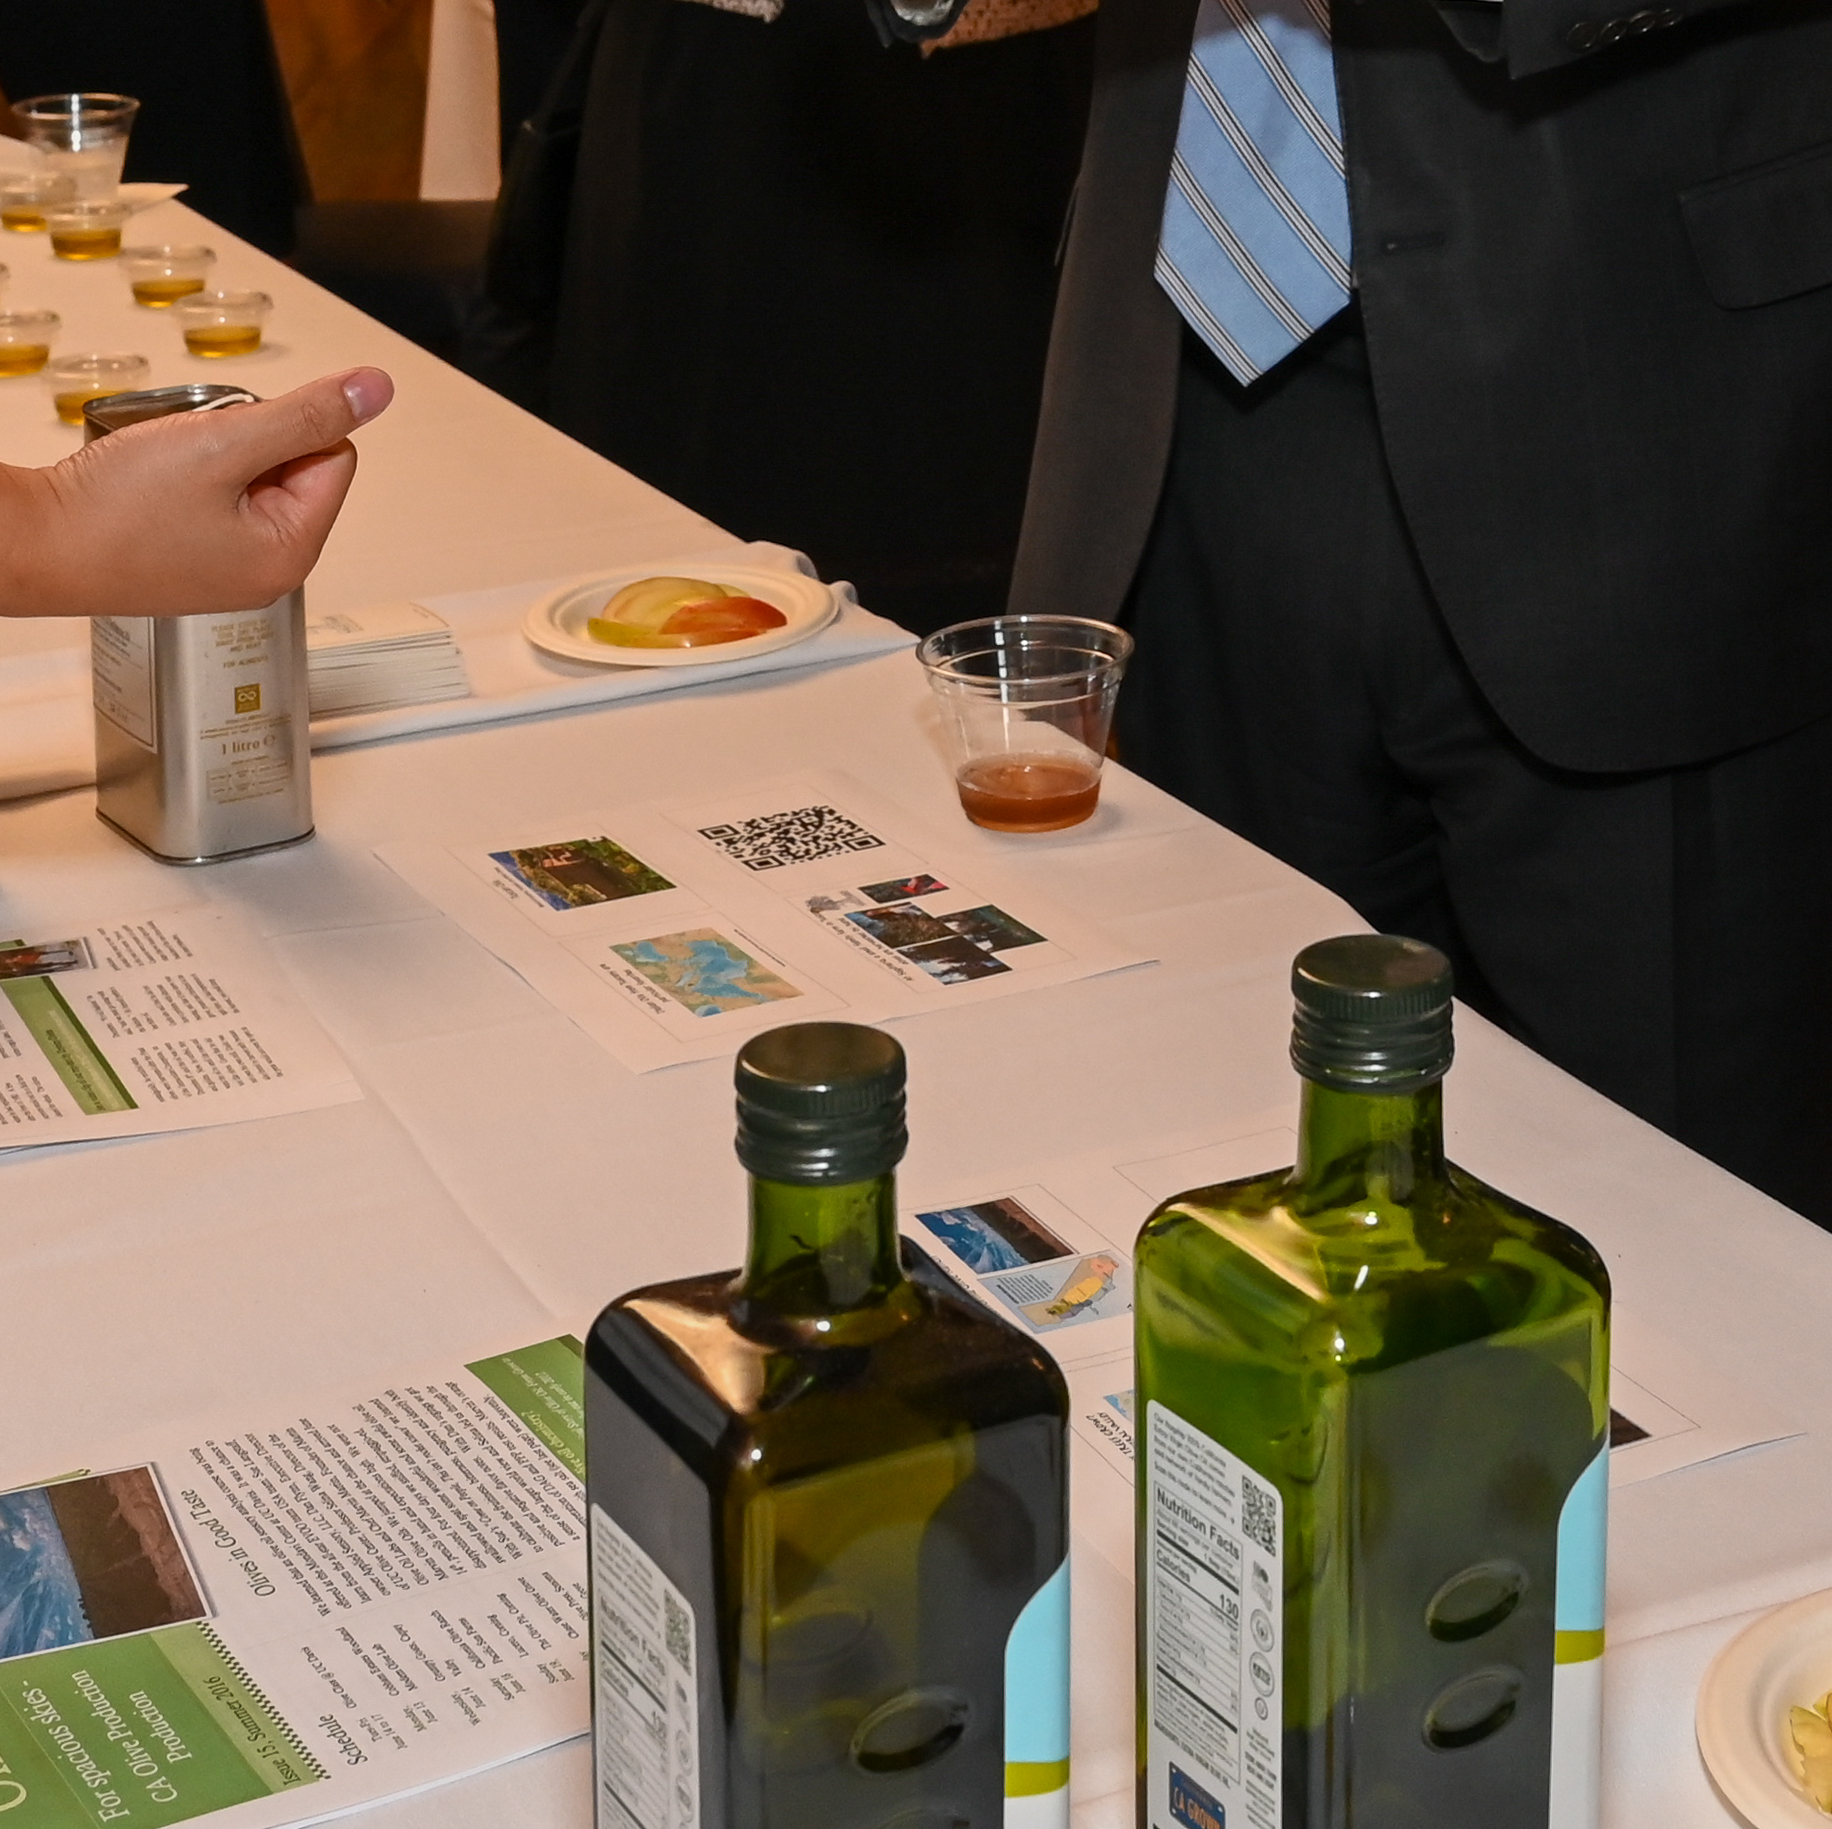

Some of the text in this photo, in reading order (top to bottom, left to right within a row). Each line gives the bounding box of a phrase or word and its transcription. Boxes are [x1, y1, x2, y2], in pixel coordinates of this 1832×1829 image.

[232, 738, 260, 754] litro
[181, 1489, 275, 1596] Olives in Good Taste
[1157, 1487, 1206, 1534] Nutrition
[1209, 1525, 1239, 1559] Facts
[1156, 1549, 1190, 1582] Calories
[1220, 1594, 1238, 1619] 130
[22, 1688, 60, 1723] skies
[129, 1691, 191, 1762] Production
[203, 1676, 301, 1785] Issue 15, Summer 2016
[49, 1725, 110, 1787] spacious
[72, 1670, 177, 1802] CA Olive Production
[318, 1714, 367, 1764] Schedule
[94, 1790, 129, 1821] For
